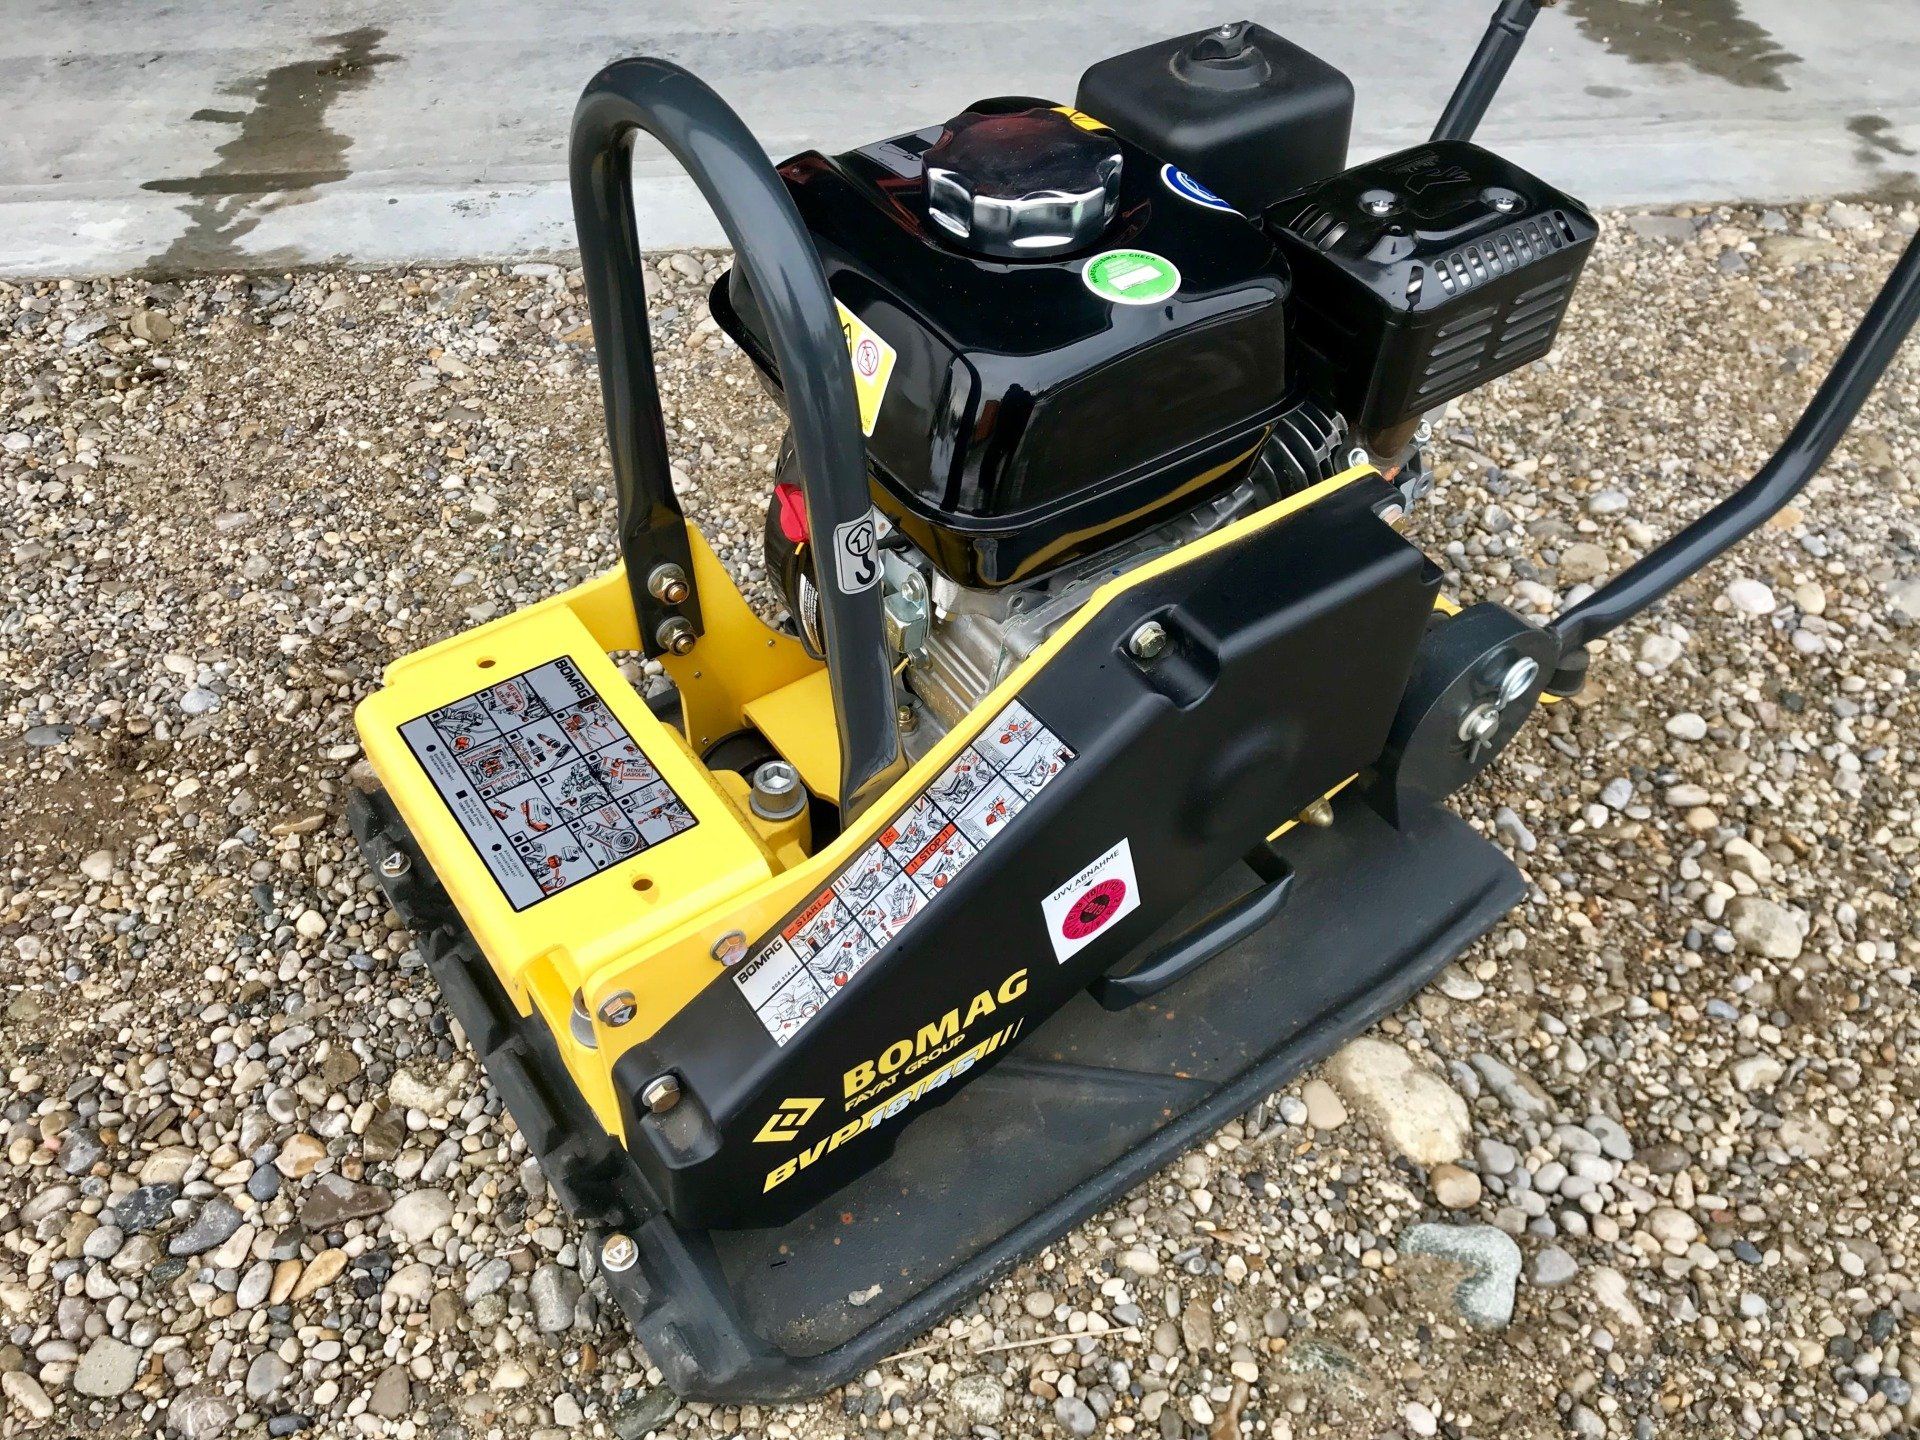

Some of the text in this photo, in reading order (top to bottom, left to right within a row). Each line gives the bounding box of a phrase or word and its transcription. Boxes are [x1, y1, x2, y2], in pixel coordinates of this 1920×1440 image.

[1090, 255, 1117, 283] WAREHOUSING
[1129, 253, 1155, 261] CHECK
[555, 660, 591, 698] BOMAG
[1019, 719, 1029, 729] ON
[989, 796, 1000, 809] OFF
[918, 839, 942, 861] STOP
[1054, 884, 1073, 901] UVV
[1075, 849, 1120, 887] ABNAHME
[795, 902, 822, 926] START
[737, 940, 783, 984] BOMAG
[843, 968, 1028, 1099] BOMAG
[844, 1033, 966, 1112] FAYAT GROUP
[763, 1116, 863, 1194] BVP
